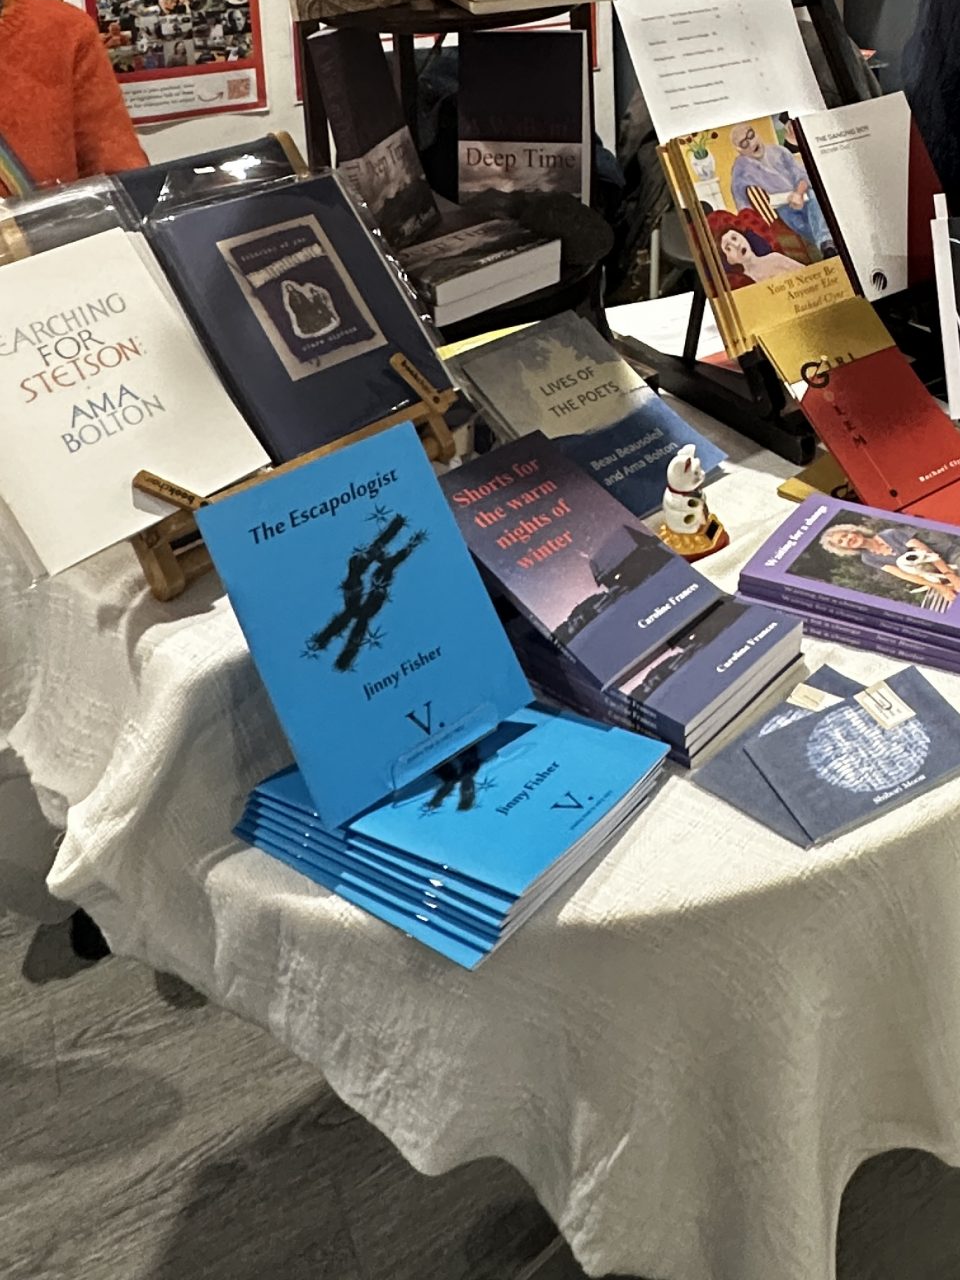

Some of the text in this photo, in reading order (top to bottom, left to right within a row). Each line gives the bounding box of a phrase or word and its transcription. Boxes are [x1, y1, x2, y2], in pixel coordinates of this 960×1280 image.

[466, 147, 578, 172] Deep Time
[815, 134, 828, 144] THE
[767, 265, 836, 295] You'll Never Be
[786, 276, 840, 301] Anyone Else
[37, 328, 106, 368] FOR
[539, 366, 596, 397] LIVES OF
[548, 380, 621, 418] THE POETS
[61, 394, 167, 454] BOLTON
[70, 384, 140, 429] AMA
[590, 427, 664, 472] Beau Beausoleil
[604, 442, 678, 487] and Ama Bolton
[453, 457, 541, 509] Shorts for
[474, 479, 558, 530] the warm
[248, 468, 399, 546] The Escapologist
[496, 497, 572, 551] nights of
[516, 529, 574, 570] winter
[764, 536, 797, 568] Waiting
[792, 527, 804, 544] for
[808, 504, 828, 526] change
[638, 582, 700, 629] Caroline Frances
[716, 621, 778, 674] Caroline Frances
[363, 644, 444, 702] Jinny Fisher
[406, 700, 446, 736] V.
[496, 760, 562, 817] Jinny Fisher
[550, 790, 594, 811] V.
[872, 774, 927, 805] Shibori Moon
